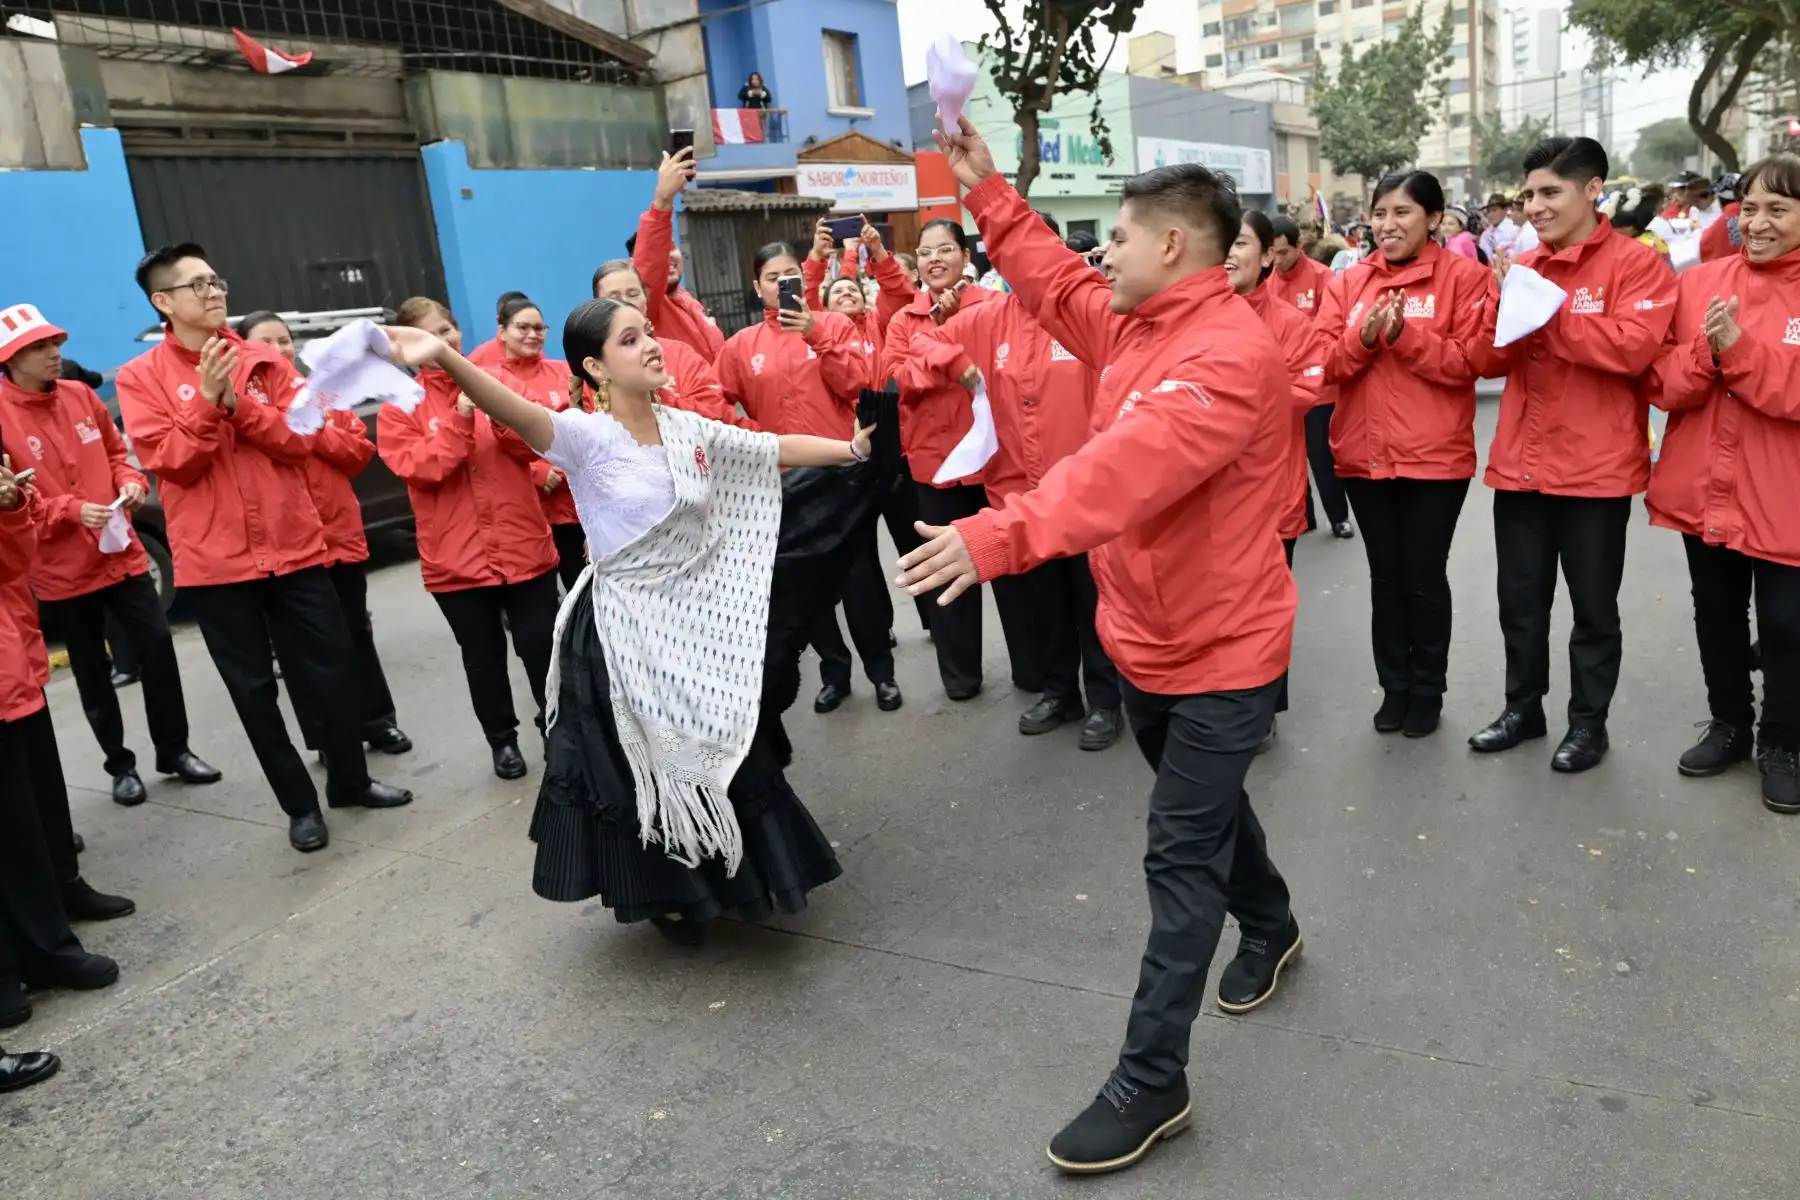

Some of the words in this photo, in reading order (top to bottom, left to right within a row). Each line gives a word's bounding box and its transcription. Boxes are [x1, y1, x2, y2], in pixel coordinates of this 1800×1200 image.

[807, 170, 846, 186] SABOR
[1576, 287, 1589, 295] VO
[1572, 301, 1605, 309] TARIOS
